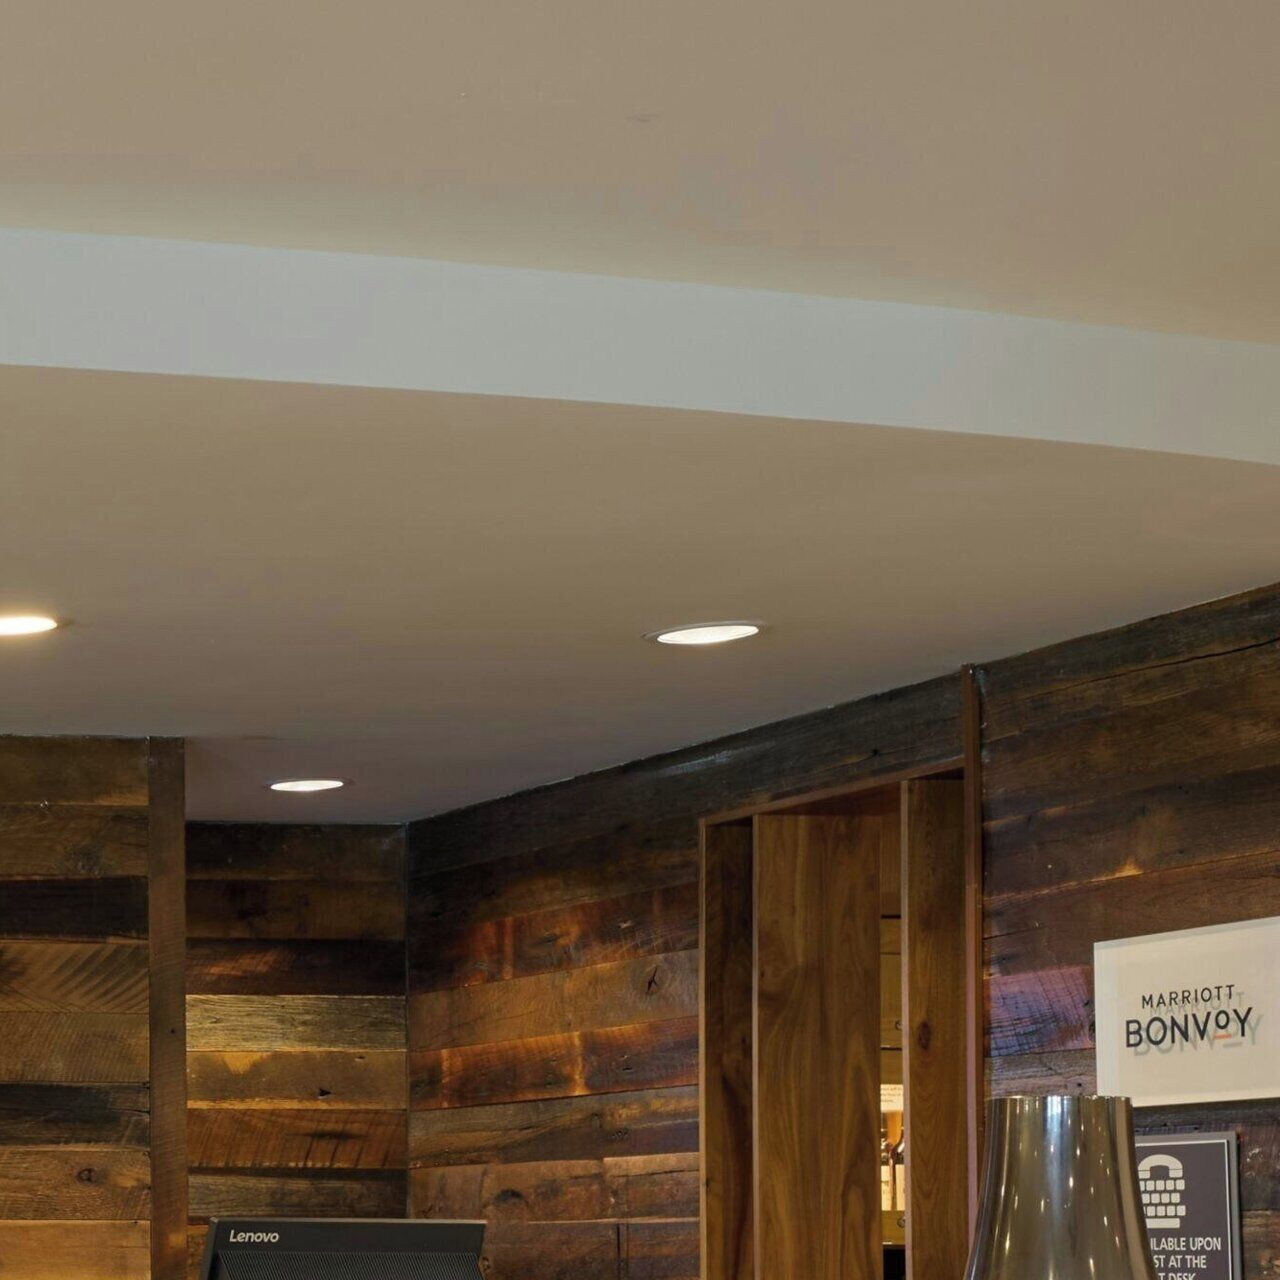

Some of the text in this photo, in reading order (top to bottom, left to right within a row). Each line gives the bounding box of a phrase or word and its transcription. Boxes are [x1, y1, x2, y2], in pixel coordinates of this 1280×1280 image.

[1141, 984, 1235, 1009] MARRIOTT
[229, 1229, 280, 1243] Lenovo
[1150, 1237, 1222, 1251] ILABLE UPON
[1168, 1254, 1183, 1268] AT
[1185, 1255, 1207, 1268] THE
